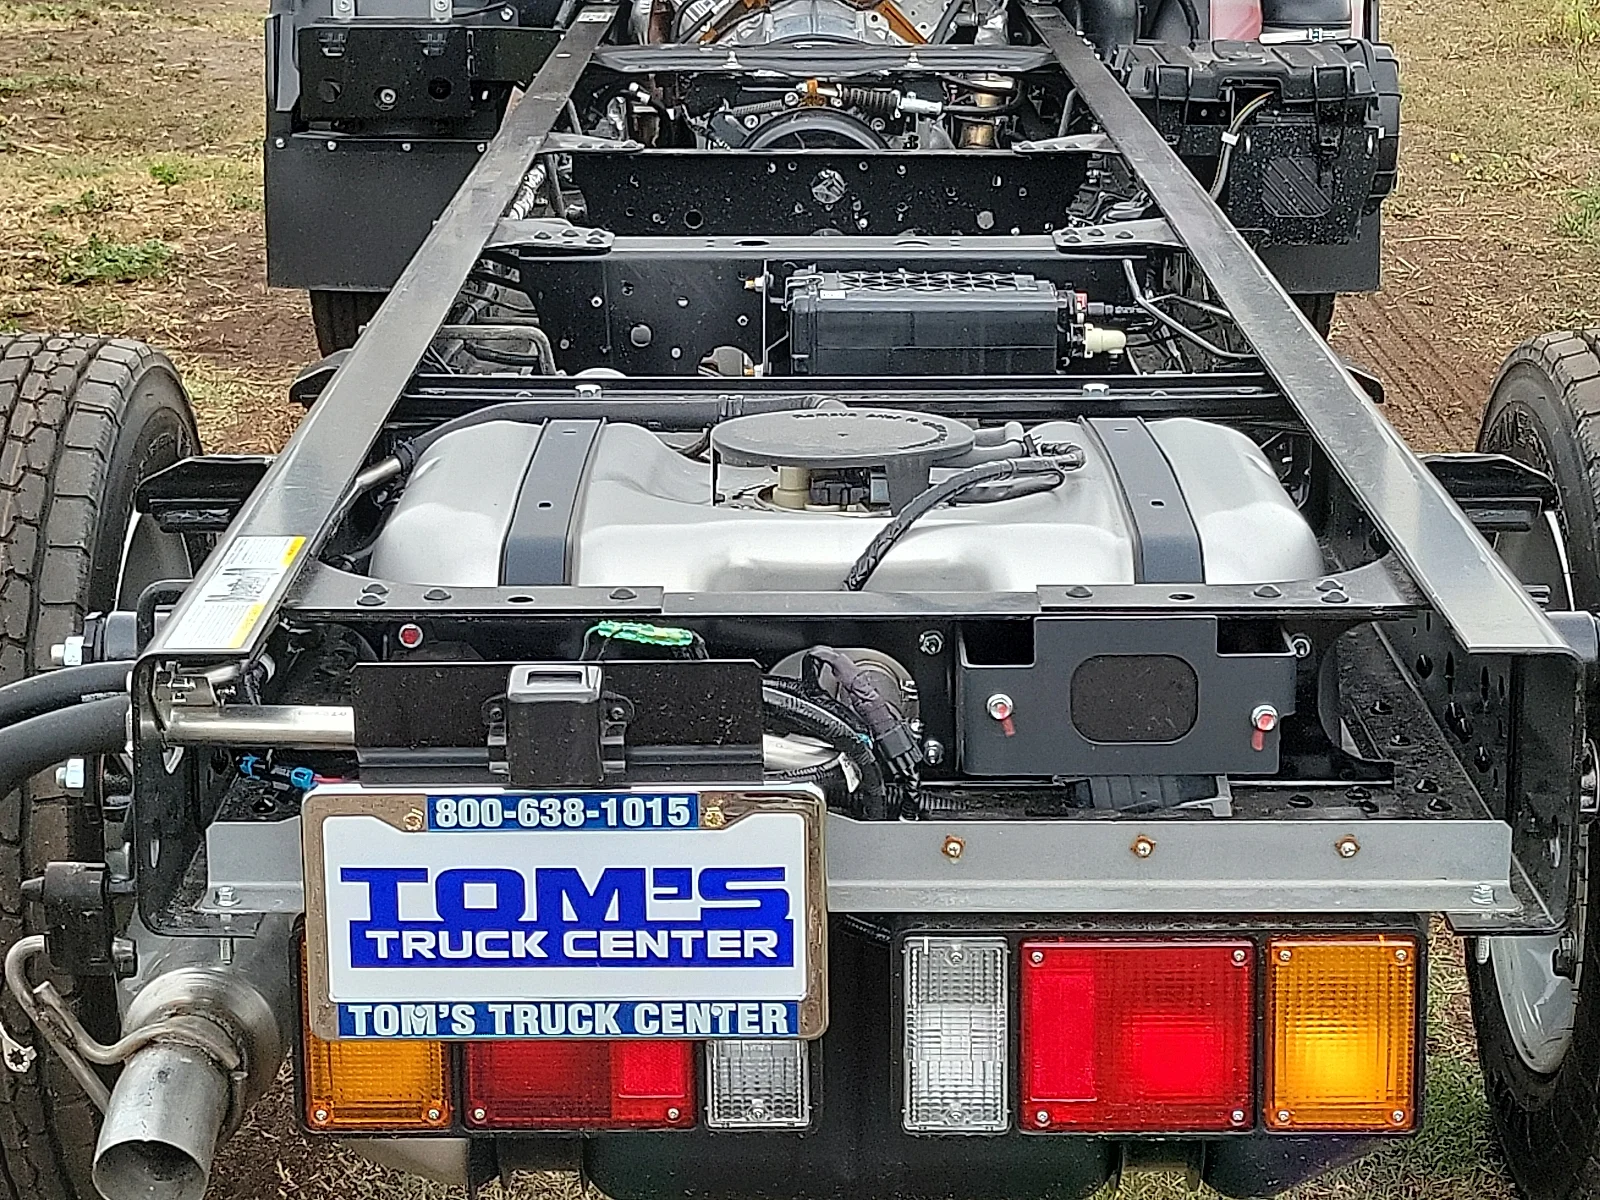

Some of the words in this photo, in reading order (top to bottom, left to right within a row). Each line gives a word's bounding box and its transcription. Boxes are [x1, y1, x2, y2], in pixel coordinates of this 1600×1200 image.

[435, 796, 691, 828] 800-638-1015
[340, 867, 790, 923] TOM'S
[365, 930, 549, 959] TRUCK
[563, 930, 778, 959] CENTER
[348, 1005, 476, 1036] TOM'S
[487, 1005, 621, 1036] TRUCK
[633, 1004, 790, 1035] CENTER
